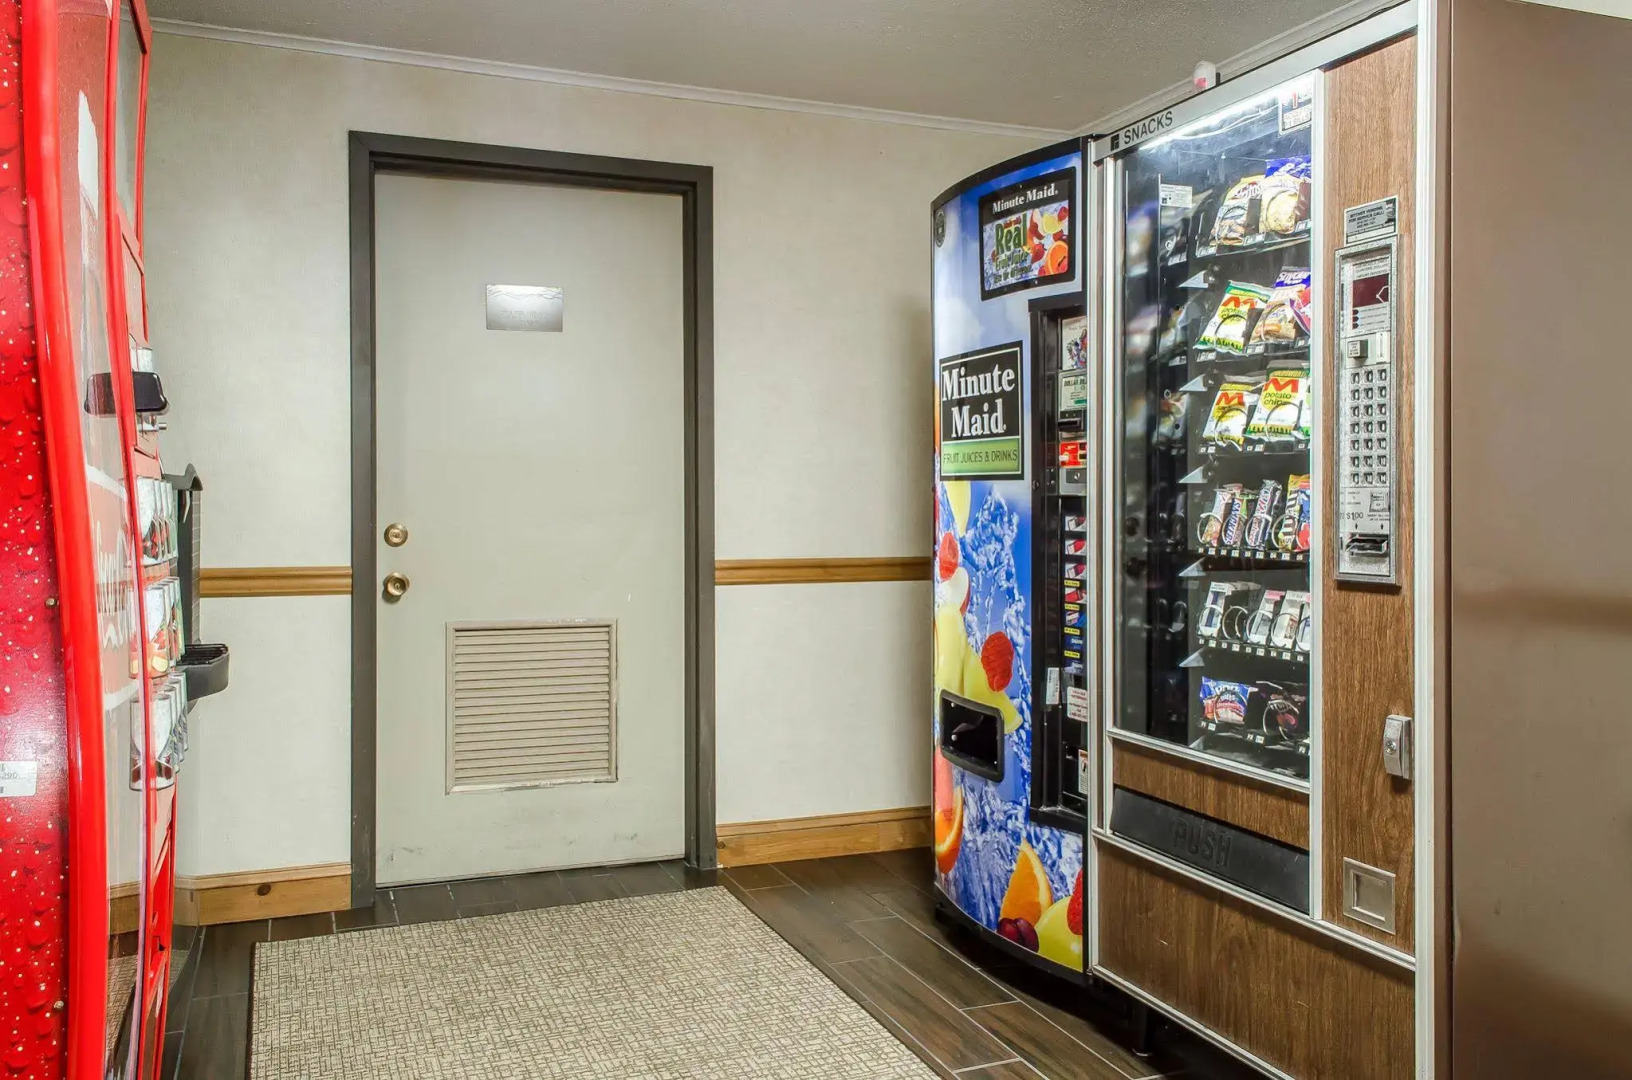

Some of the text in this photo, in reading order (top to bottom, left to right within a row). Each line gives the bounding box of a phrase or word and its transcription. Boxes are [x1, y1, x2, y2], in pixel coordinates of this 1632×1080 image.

[1124, 111, 1173, 145] SNACKS
[992, 196, 1025, 214] Minute
[995, 212, 1028, 255] Real
[942, 363, 1015, 401] Minute
[1215, 391, 1246, 407] M
[1263, 377, 1300, 393] M
[951, 398, 1005, 438] Maid
[943, 449, 1018, 464] FRUIT JUICES & DRINKS
[1225, 500, 1242, 545] SNICKERS
[1173, 817, 1233, 869] PUSH
